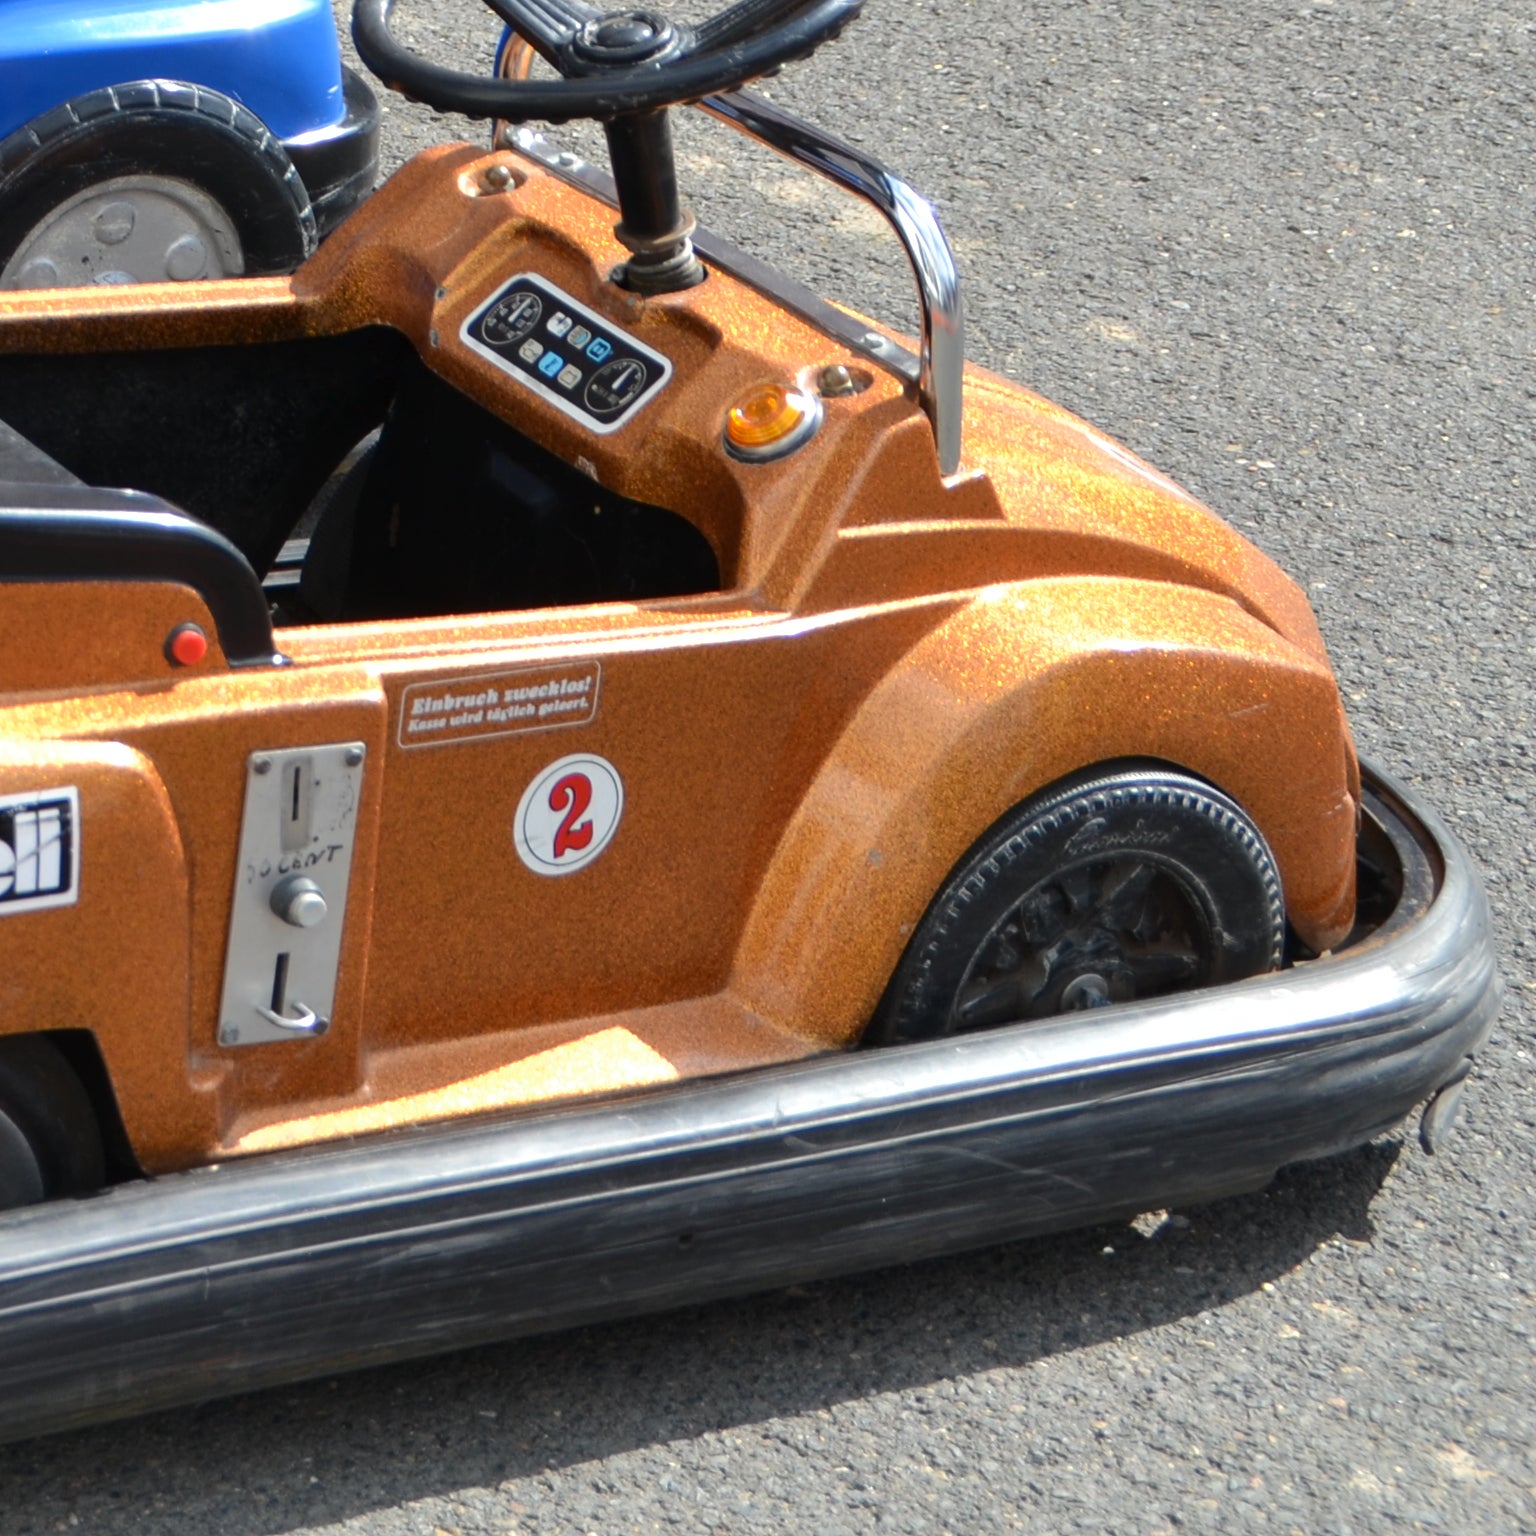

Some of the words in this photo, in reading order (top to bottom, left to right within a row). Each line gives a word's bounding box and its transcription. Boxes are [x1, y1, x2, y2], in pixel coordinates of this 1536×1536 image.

[412, 689, 498, 715] Einbruch
[504, 675, 592, 703] zwecklos!
[407, 717, 446, 733] Kasse
[449, 710, 483, 727] wird
[487, 703, 536, 722] täglich
[547, 772, 593, 858] 2
